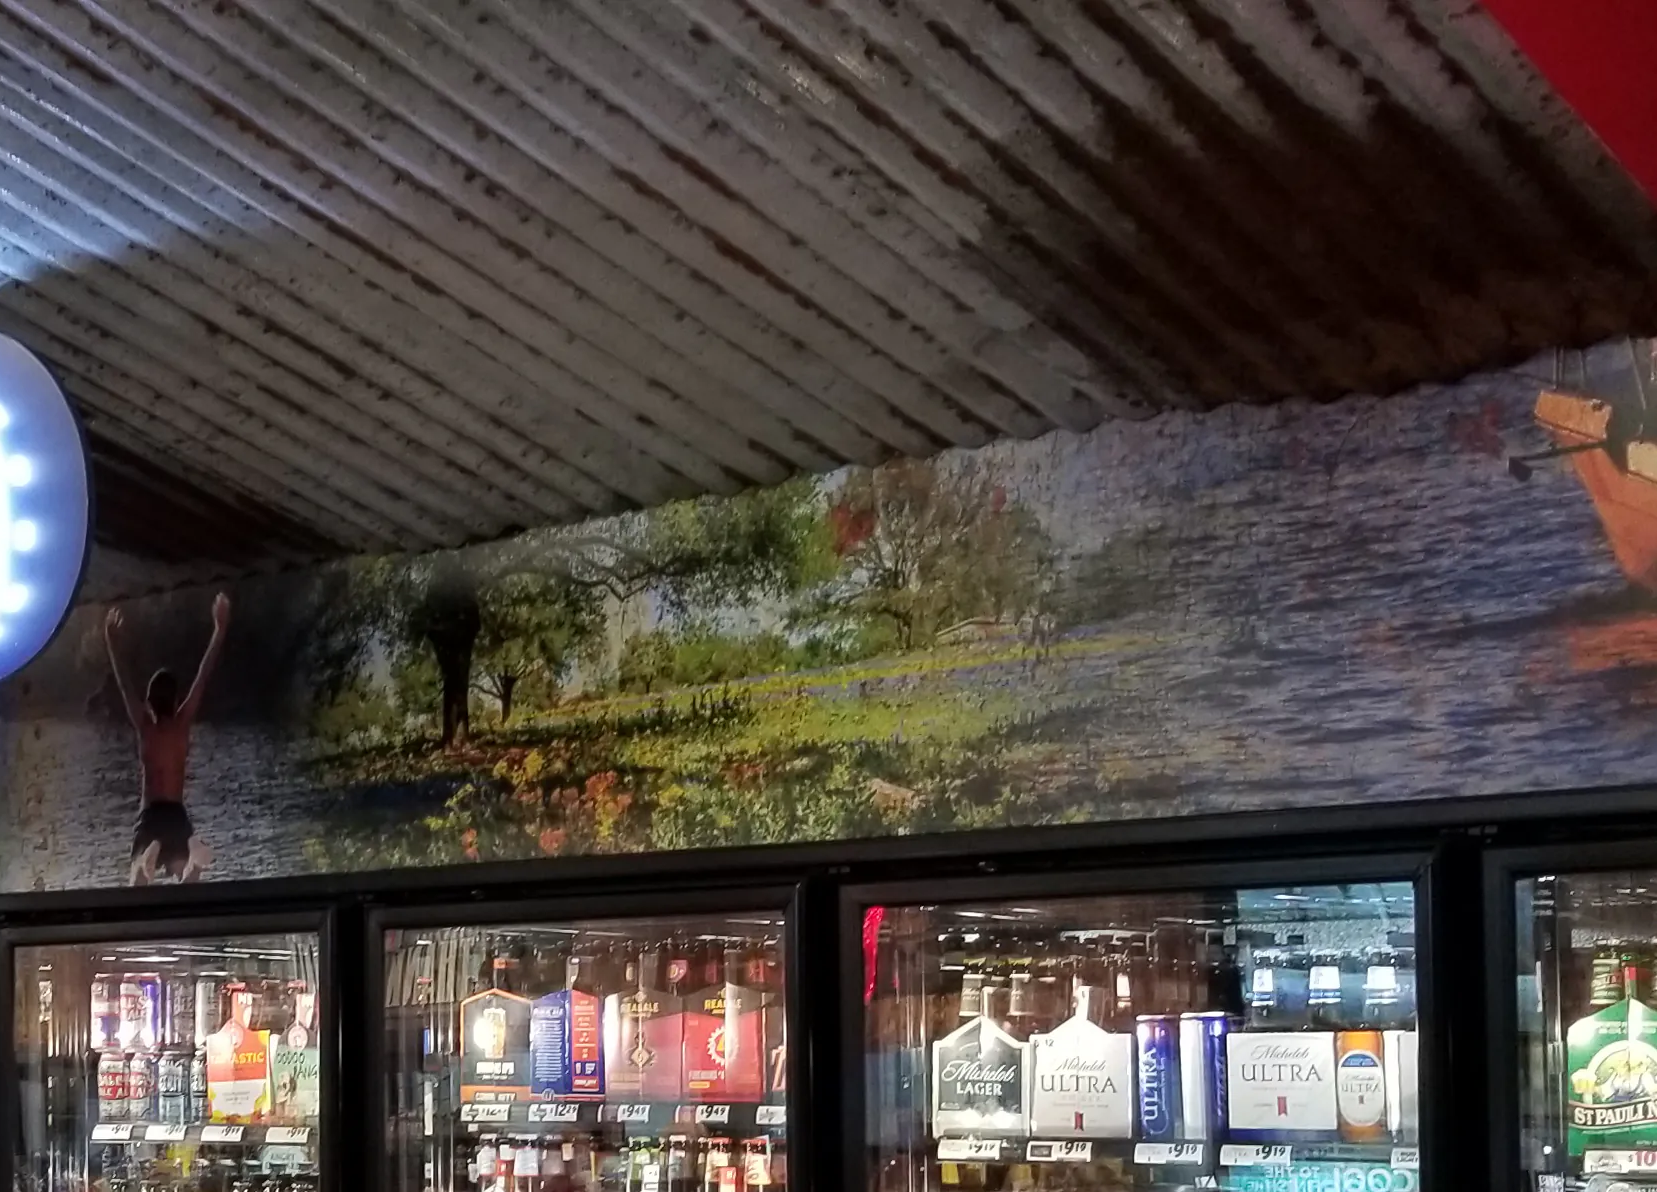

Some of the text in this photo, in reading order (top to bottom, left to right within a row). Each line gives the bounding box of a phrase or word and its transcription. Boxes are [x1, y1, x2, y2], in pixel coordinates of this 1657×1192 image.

[1251, 1044, 1310, 1059] Michelob
[942, 1060, 1017, 1084] Michelob
[1054, 1056, 1107, 1072] Michelob
[1241, 1063, 1323, 1083] ULTRA
[956, 1082, 1003, 1096] LAGER
[1041, 1074, 1117, 1094] ULTRA
[1141, 1047, 1158, 1122] ULTRA
[1341, 1081, 1381, 1093] ULTRA
[1574, 1106, 1594, 1125] ST
[1628, 1150, 1657, 1168] $10
